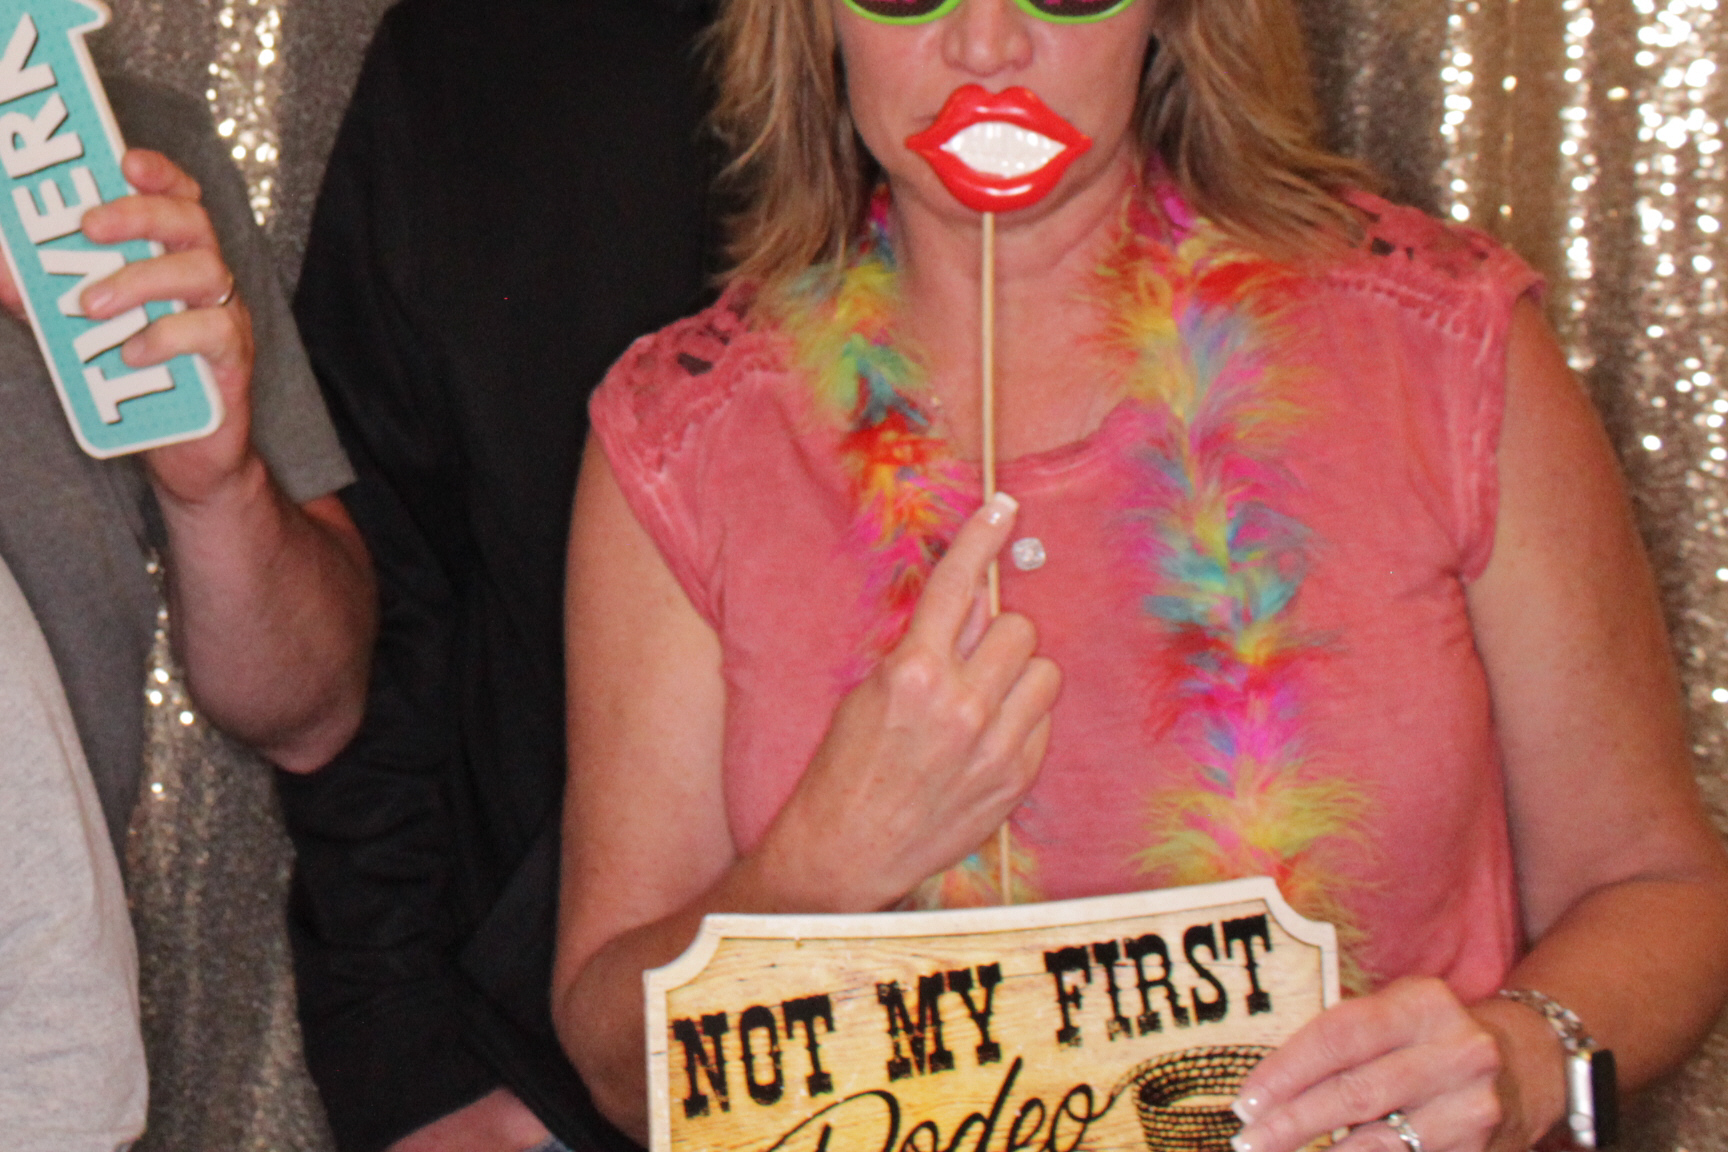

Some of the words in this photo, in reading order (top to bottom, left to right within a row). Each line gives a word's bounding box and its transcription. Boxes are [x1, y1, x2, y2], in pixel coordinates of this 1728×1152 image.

[672, 992, 836, 1120] NOT
[875, 961, 1004, 1083] MY
[1044, 913, 1273, 1049] FIRST
